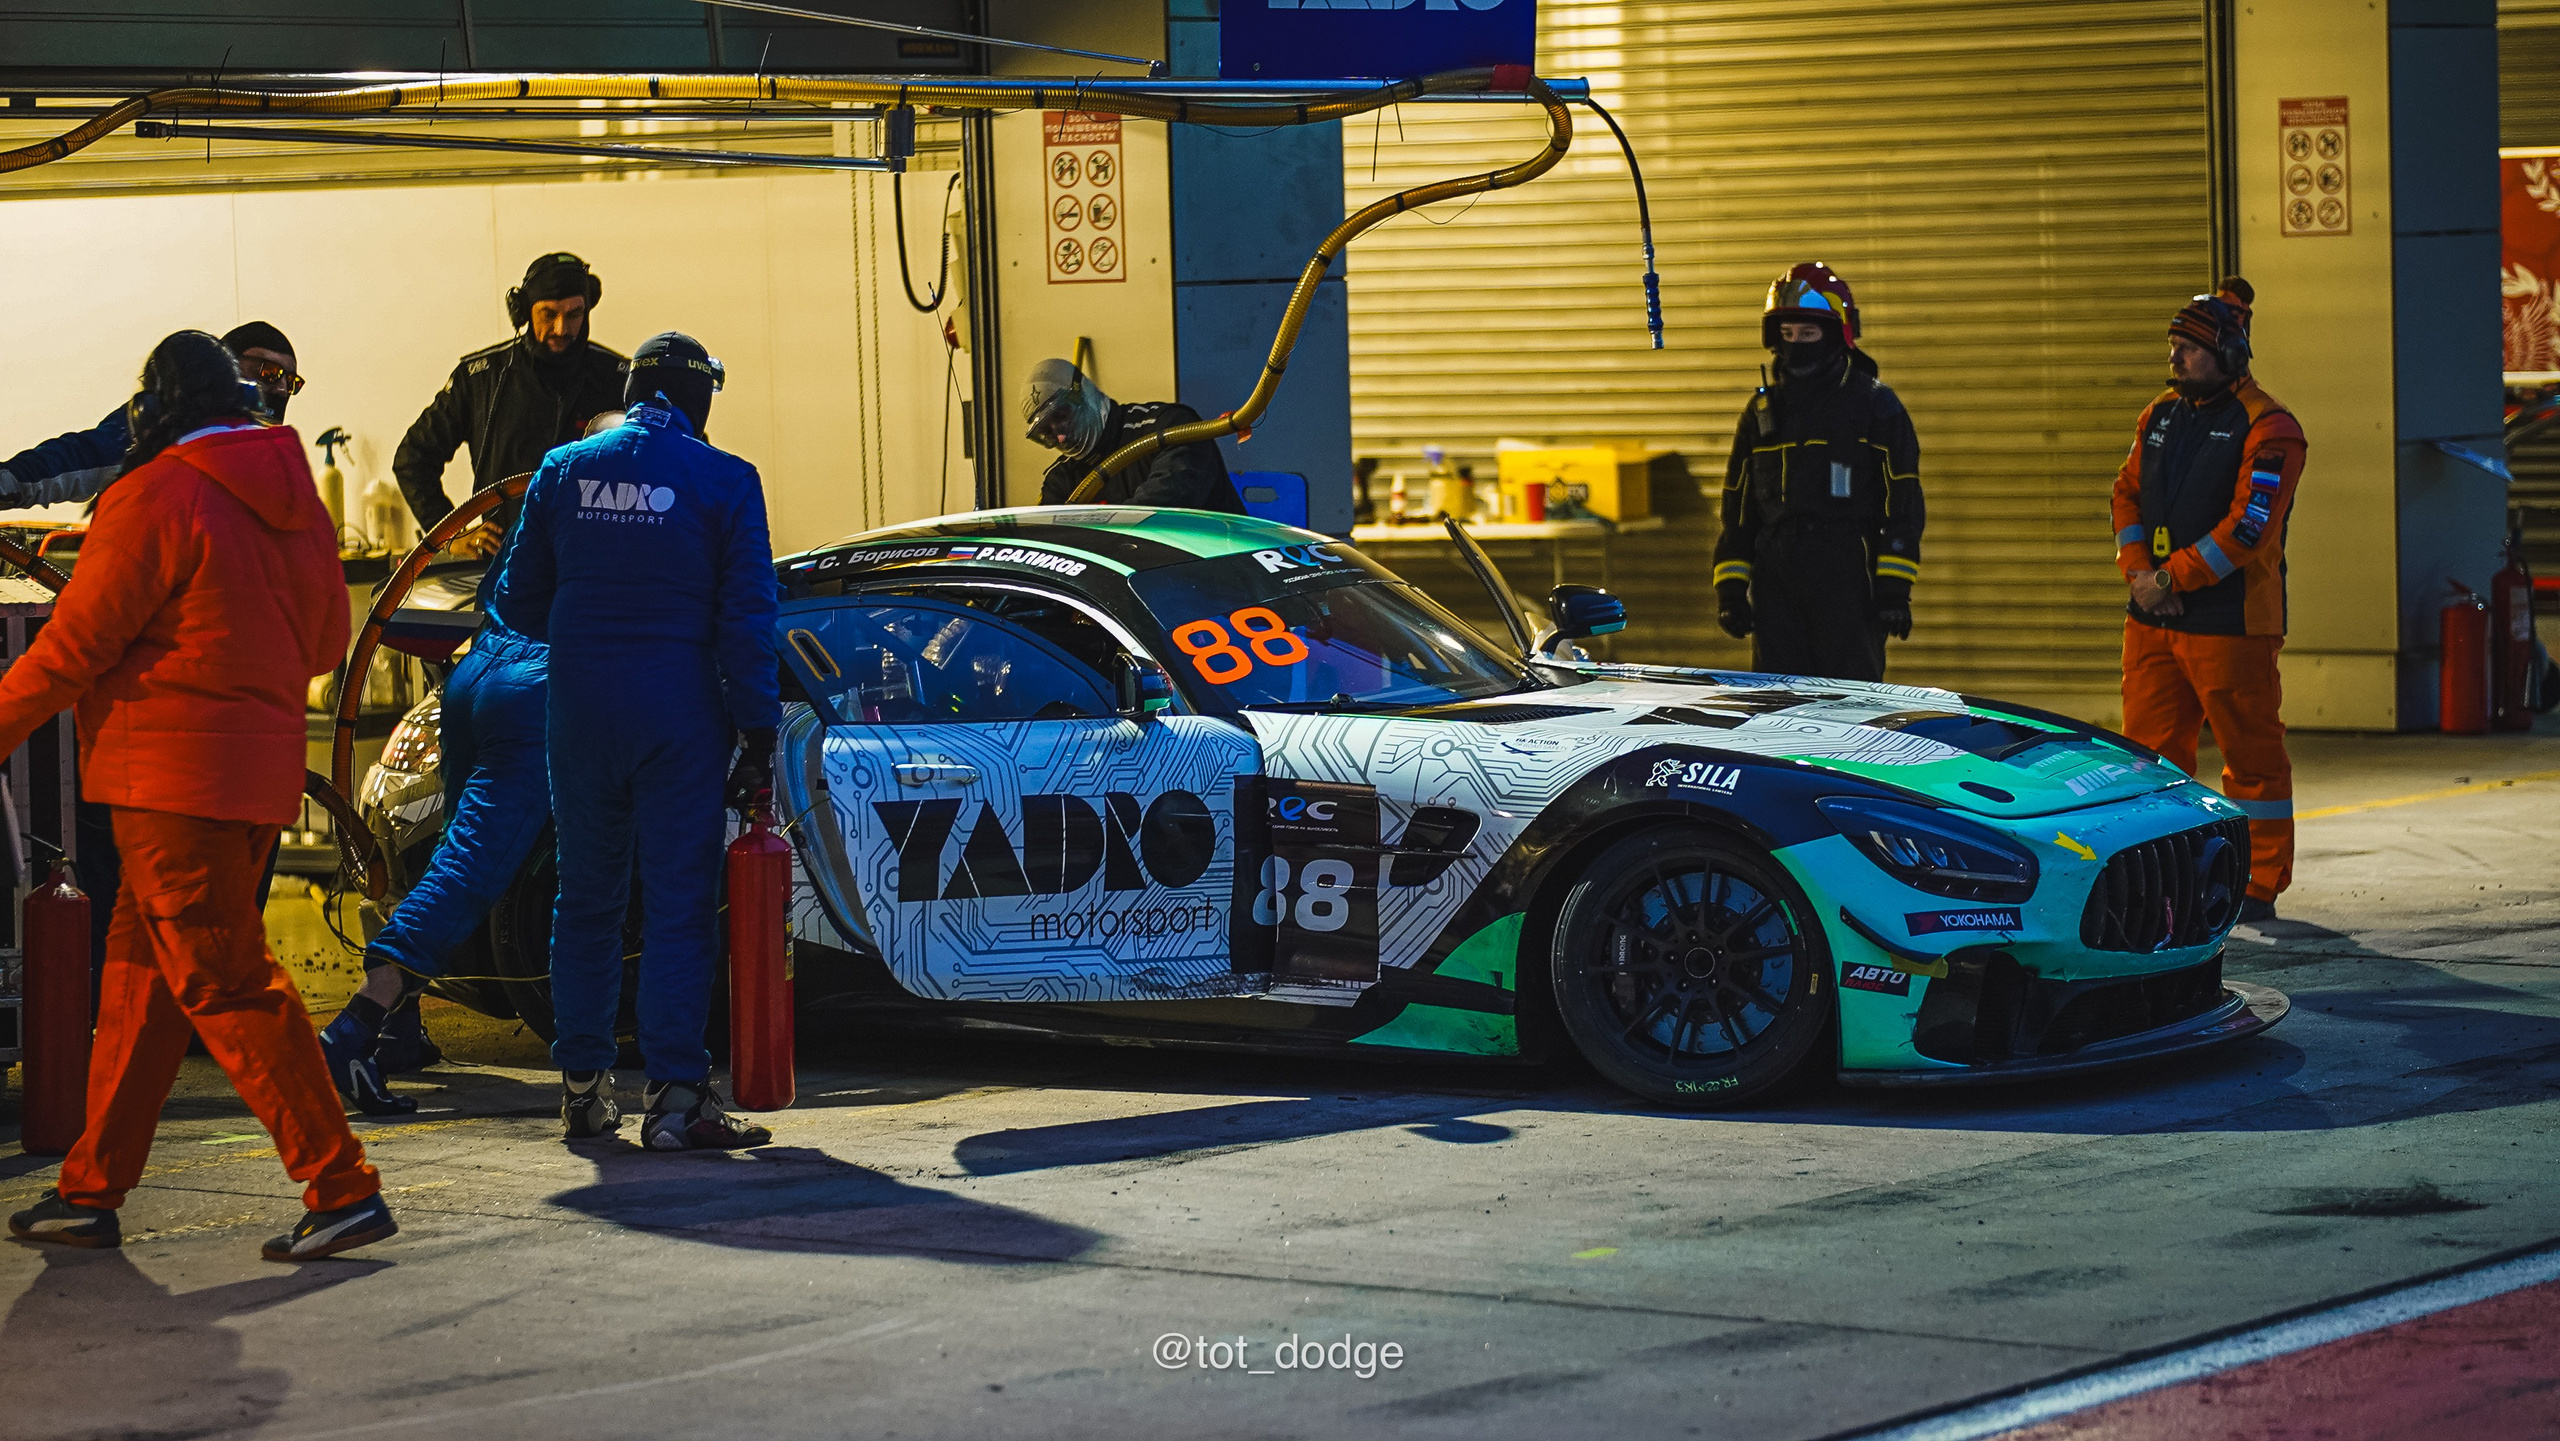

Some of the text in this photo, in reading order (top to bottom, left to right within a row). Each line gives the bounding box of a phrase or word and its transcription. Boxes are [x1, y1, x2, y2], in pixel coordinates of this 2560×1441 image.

[688, 360, 713, 375] uvex
[578, 479, 676, 513] YADRO
[576, 511, 665, 526] MOTORSPORT
[818, 546, 940, 570] С. Борисов
[976, 546, 1088, 577] Р.САЛИХОВ
[1172, 606, 1309, 685] 88
[1528, 738, 1560, 746] ACTION
[1682, 762, 1741, 790] SILA
[871, 788, 1216, 903] YADRO
[1252, 854, 1355, 932] 88
[1030, 896, 1214, 943] motorsport
[1940, 913, 2015, 927] YOKOHAMA
[1849, 966, 1906, 984] АВТО
